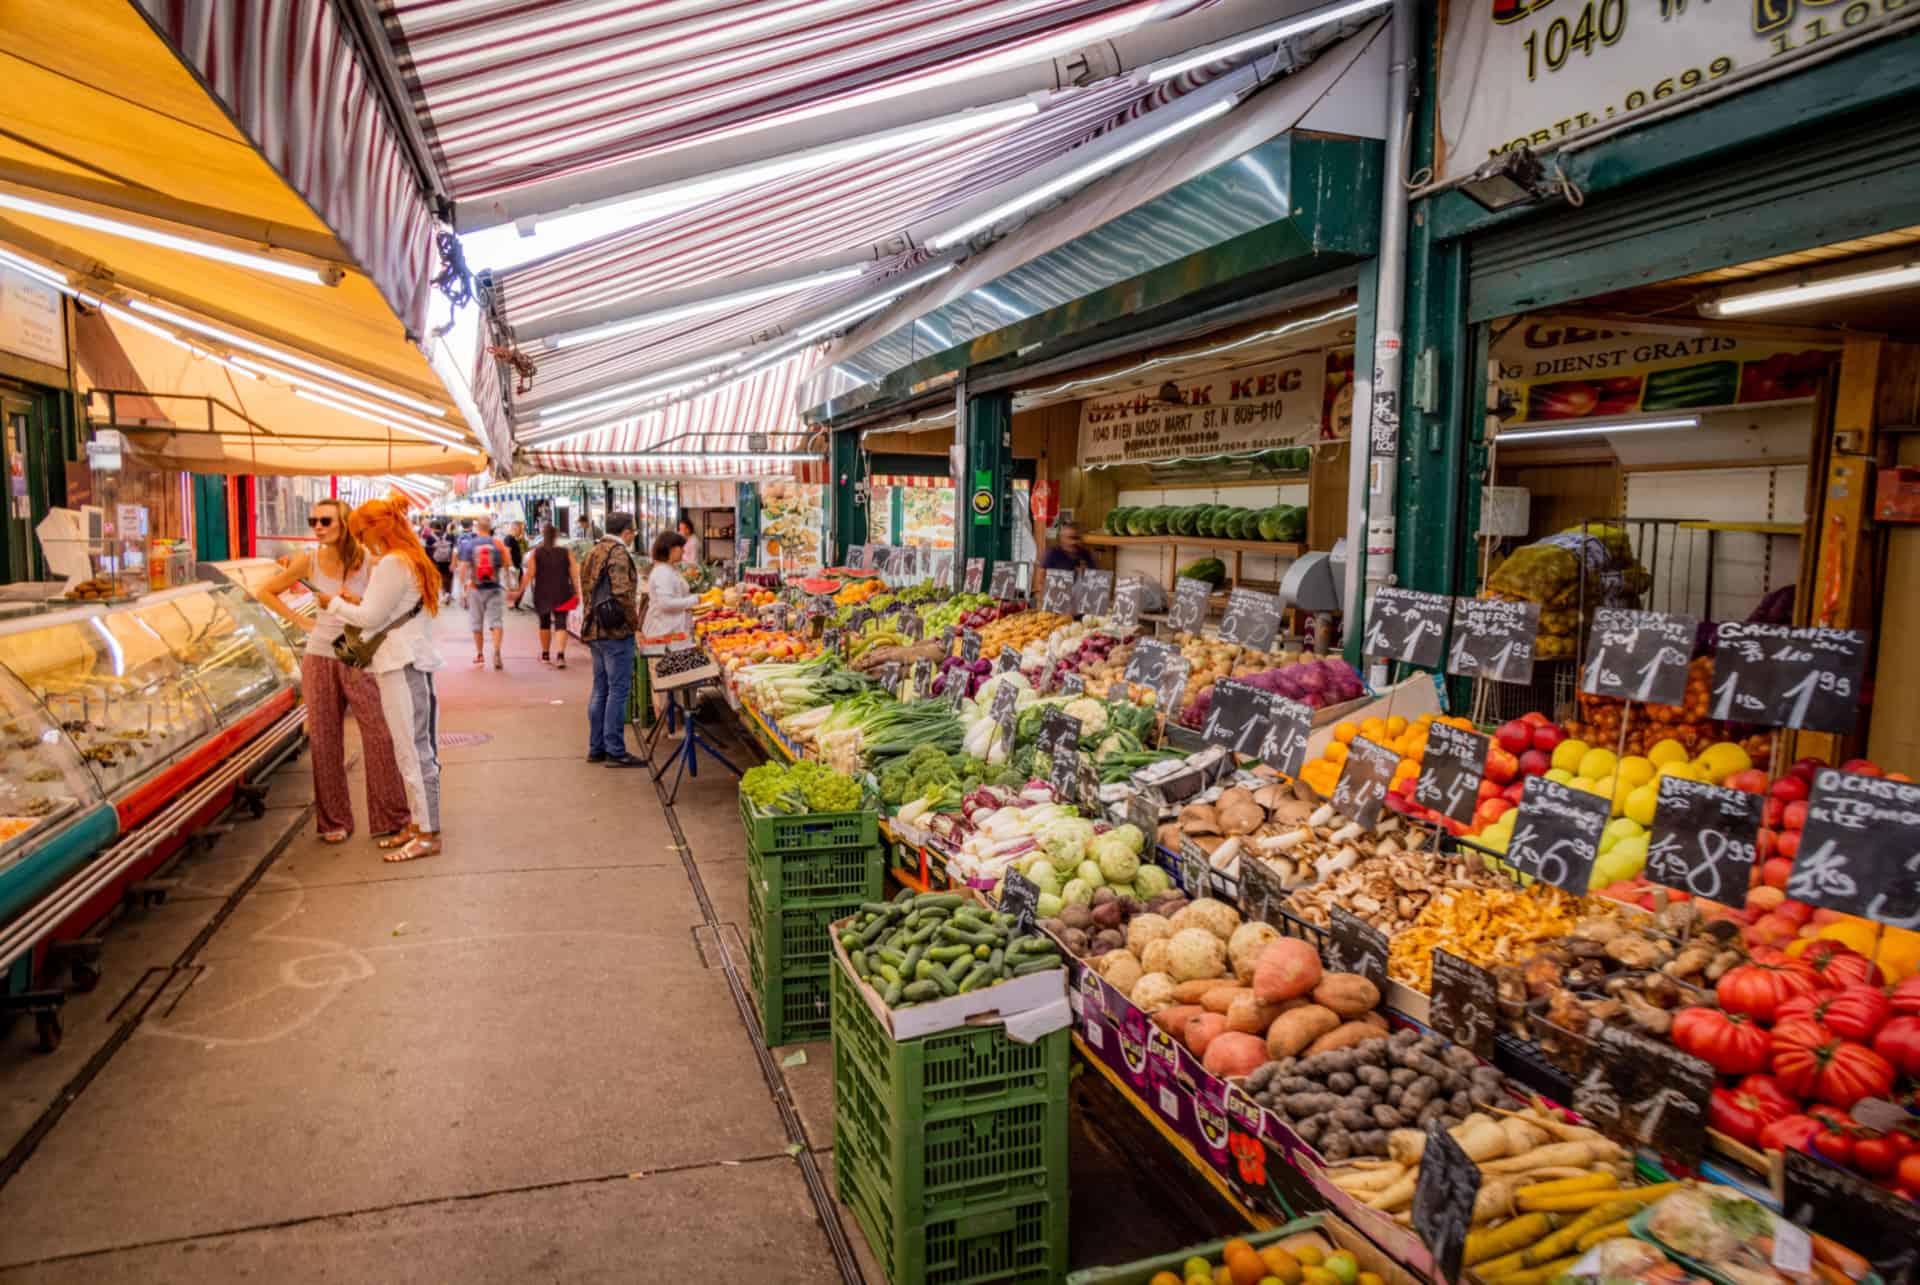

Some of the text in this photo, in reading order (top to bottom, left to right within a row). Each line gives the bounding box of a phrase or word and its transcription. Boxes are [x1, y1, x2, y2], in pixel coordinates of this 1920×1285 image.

[1522, 0, 1628, 82] 1040
[1625, 55, 1732, 111] 0699
[1535, 350, 1627, 377] DIENST
[1632, 335, 1737, 363] GRATIS
[1230, 369, 1303, 401] KEG
